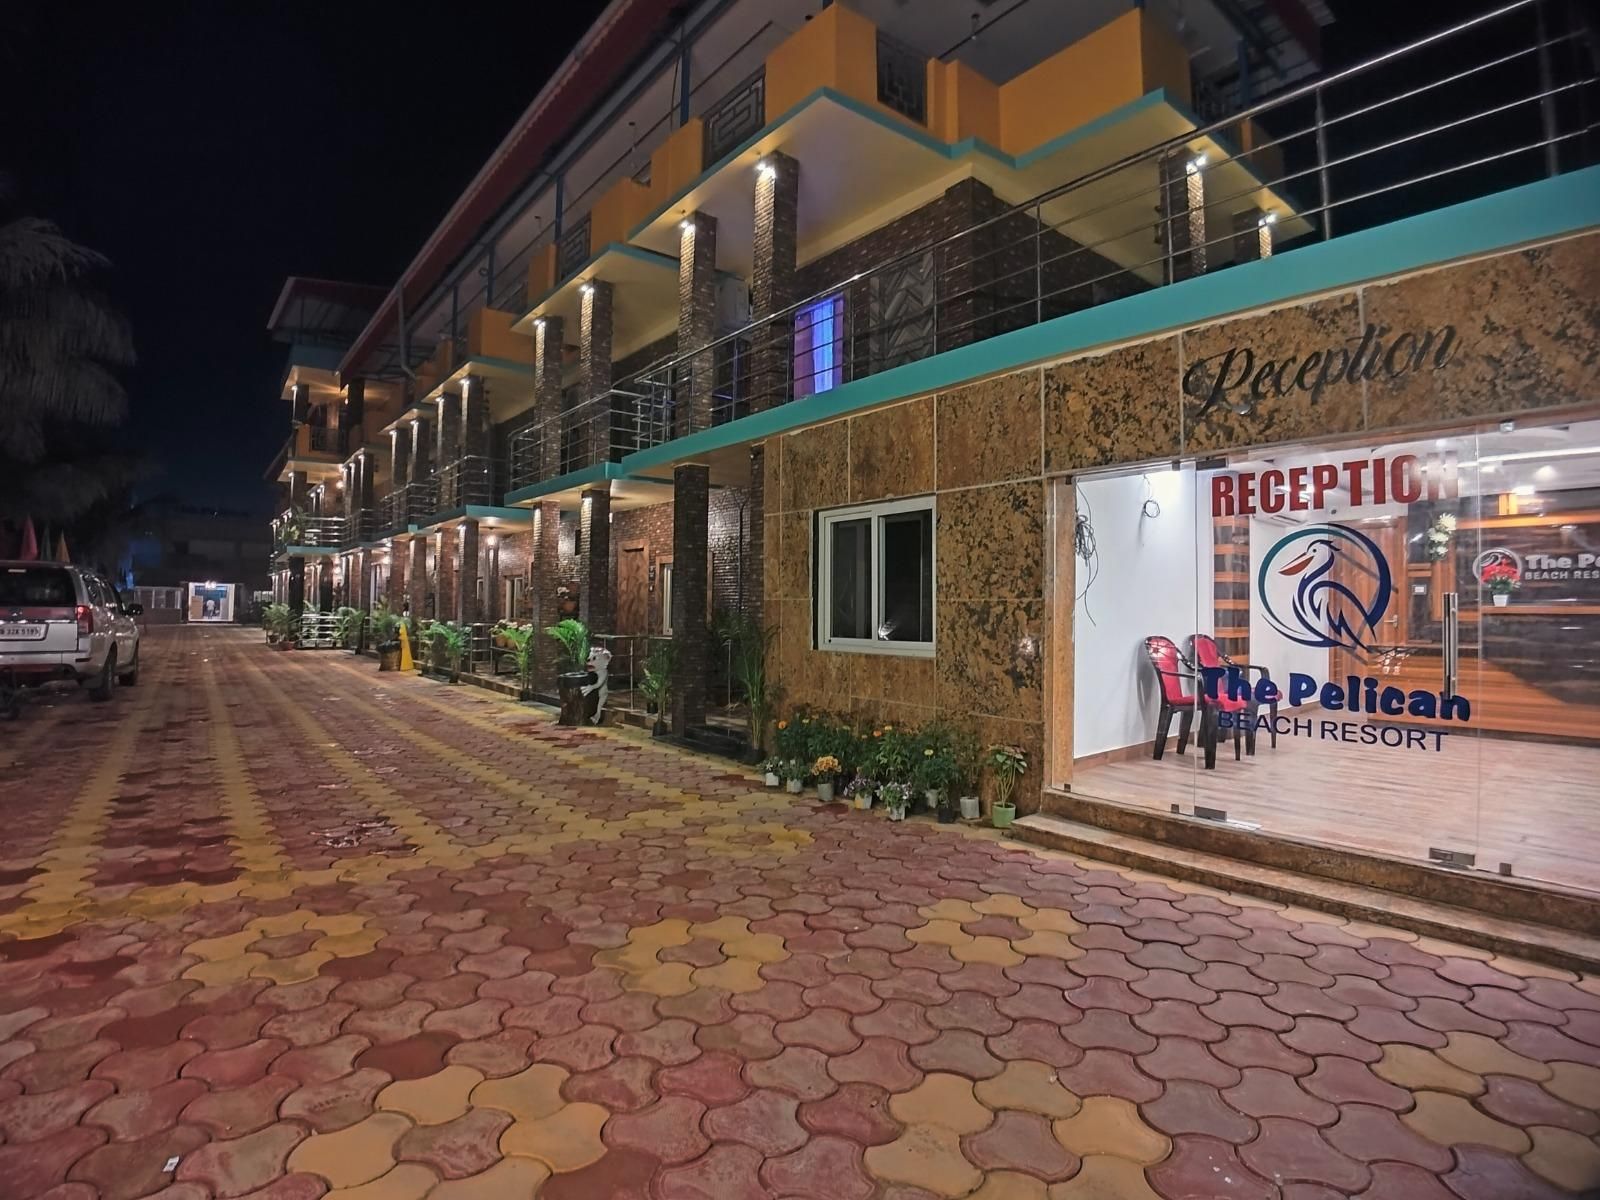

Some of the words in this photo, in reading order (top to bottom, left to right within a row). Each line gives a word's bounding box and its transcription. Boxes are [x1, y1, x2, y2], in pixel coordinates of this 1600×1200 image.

[1182, 324, 1461, 416] Reception
[1525, 555, 1572, 569] The
[1525, 571, 1568, 580] BEACH
[1201, 667, 1278, 703] The
[1289, 673, 1470, 721] Pelican
[1218, 711, 1312, 737] BEACH
[1320, 720, 1448, 751] RESORT
